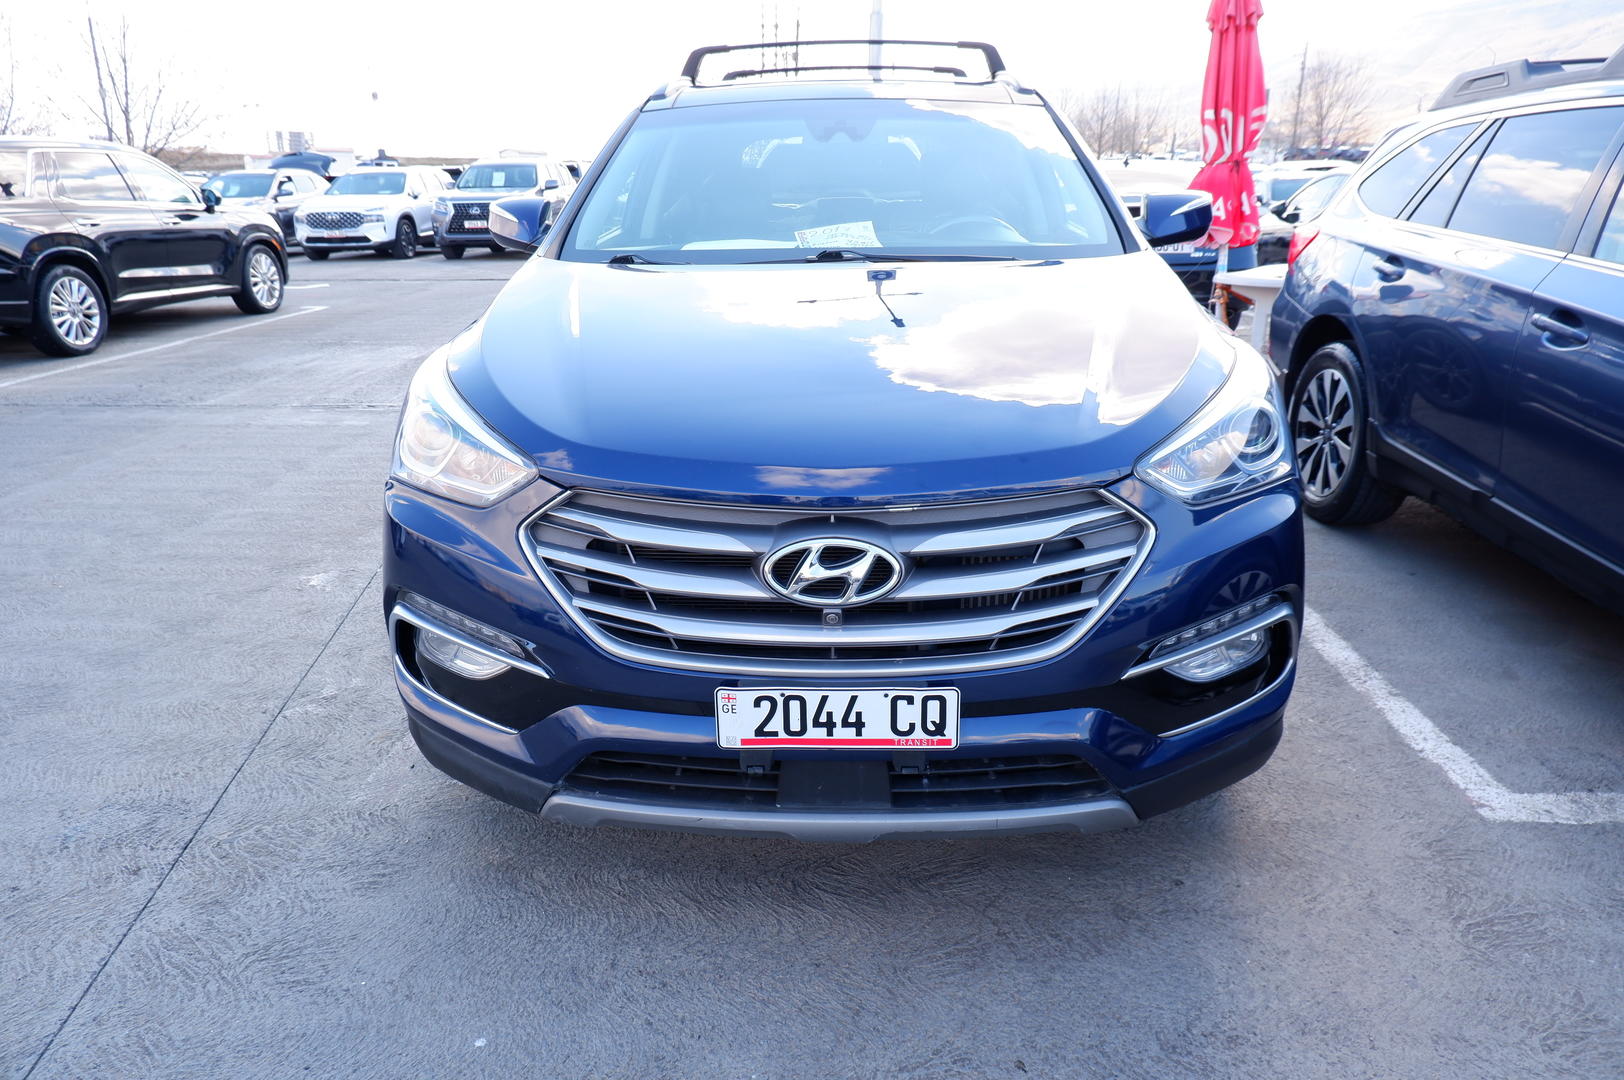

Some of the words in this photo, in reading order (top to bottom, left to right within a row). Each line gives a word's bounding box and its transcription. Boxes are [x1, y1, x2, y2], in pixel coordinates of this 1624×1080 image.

[721, 703, 737, 714] GE
[753, 694, 866, 738] 2044
[890, 694, 947, 738] CQ
[893, 738, 938, 746] TRANSIT
